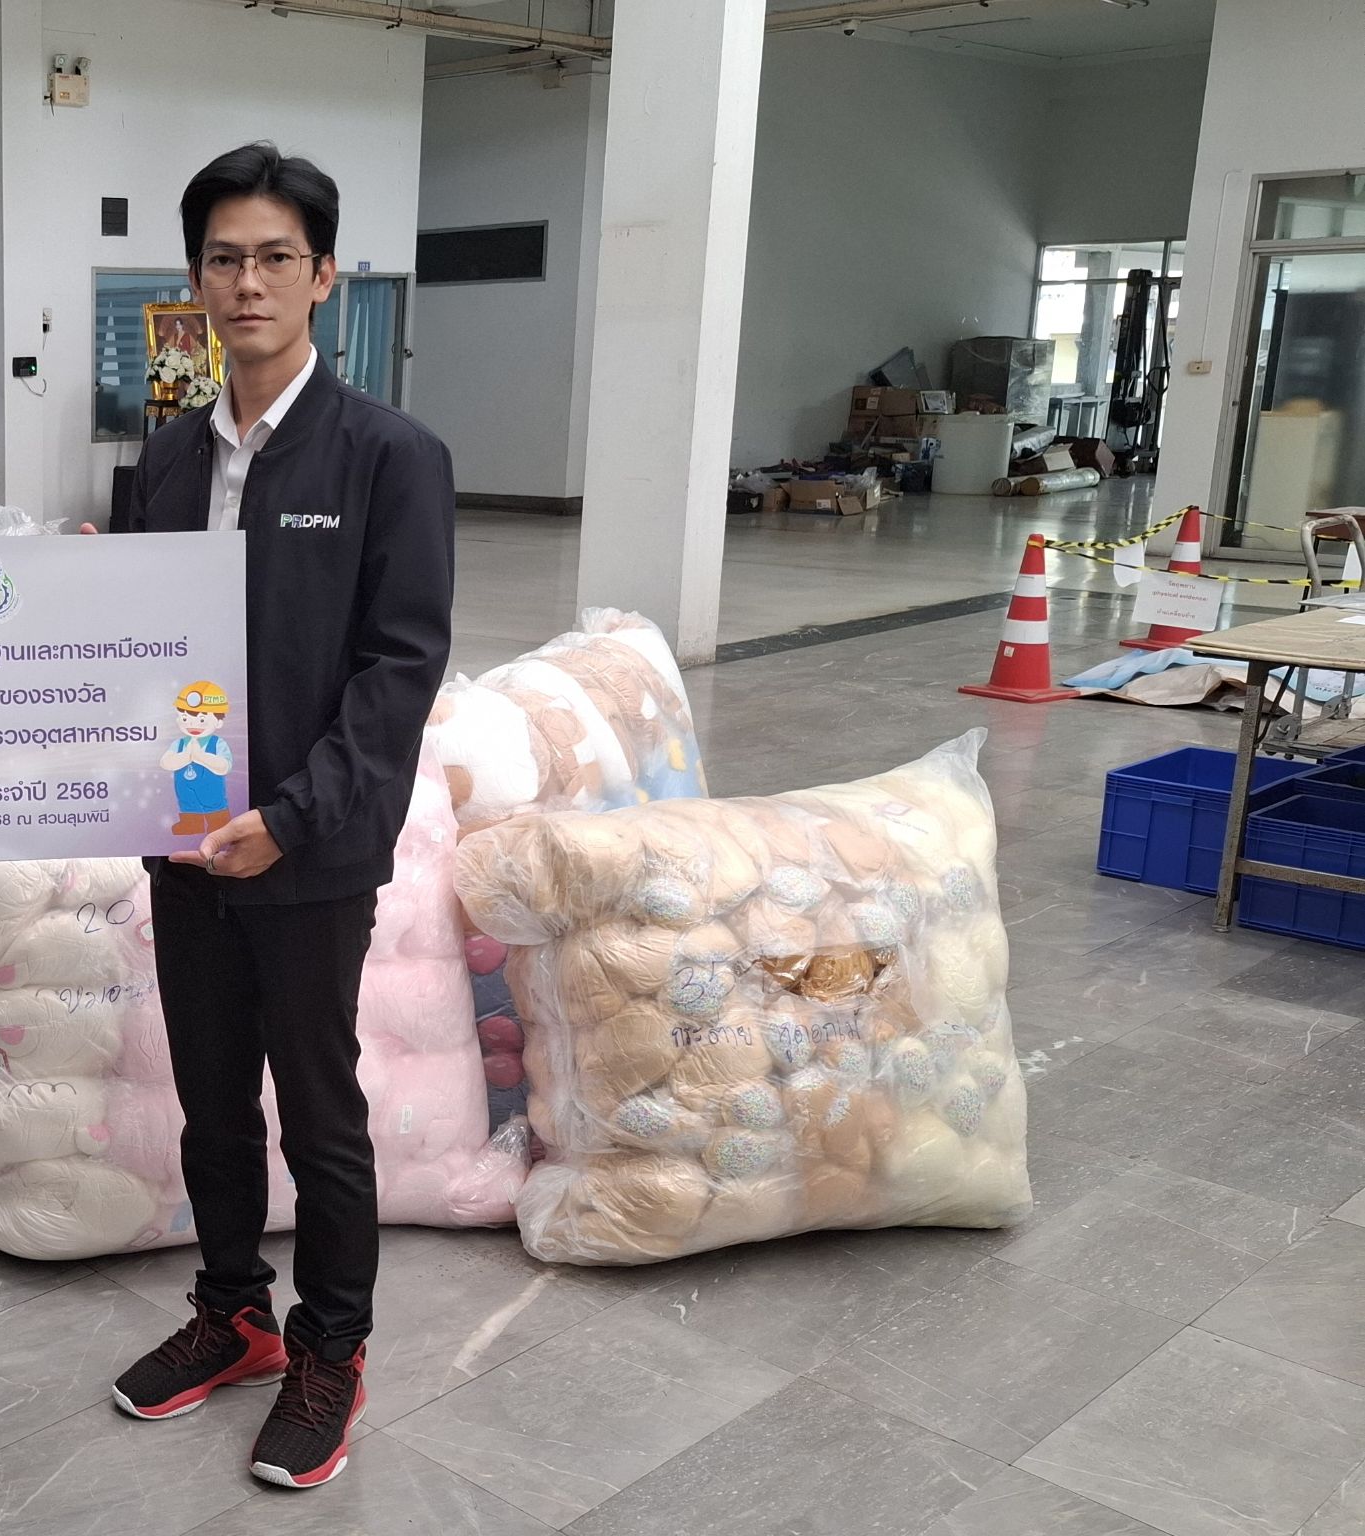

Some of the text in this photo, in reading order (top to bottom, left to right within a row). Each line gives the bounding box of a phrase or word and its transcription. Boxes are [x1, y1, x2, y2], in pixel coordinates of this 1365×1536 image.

[56, 781, 109, 800] 2568
[17, 814, 32, 826] ณ
[37, 809, 110, 828] สวนลุมพินี
[76, 899, 135, 934] 20
